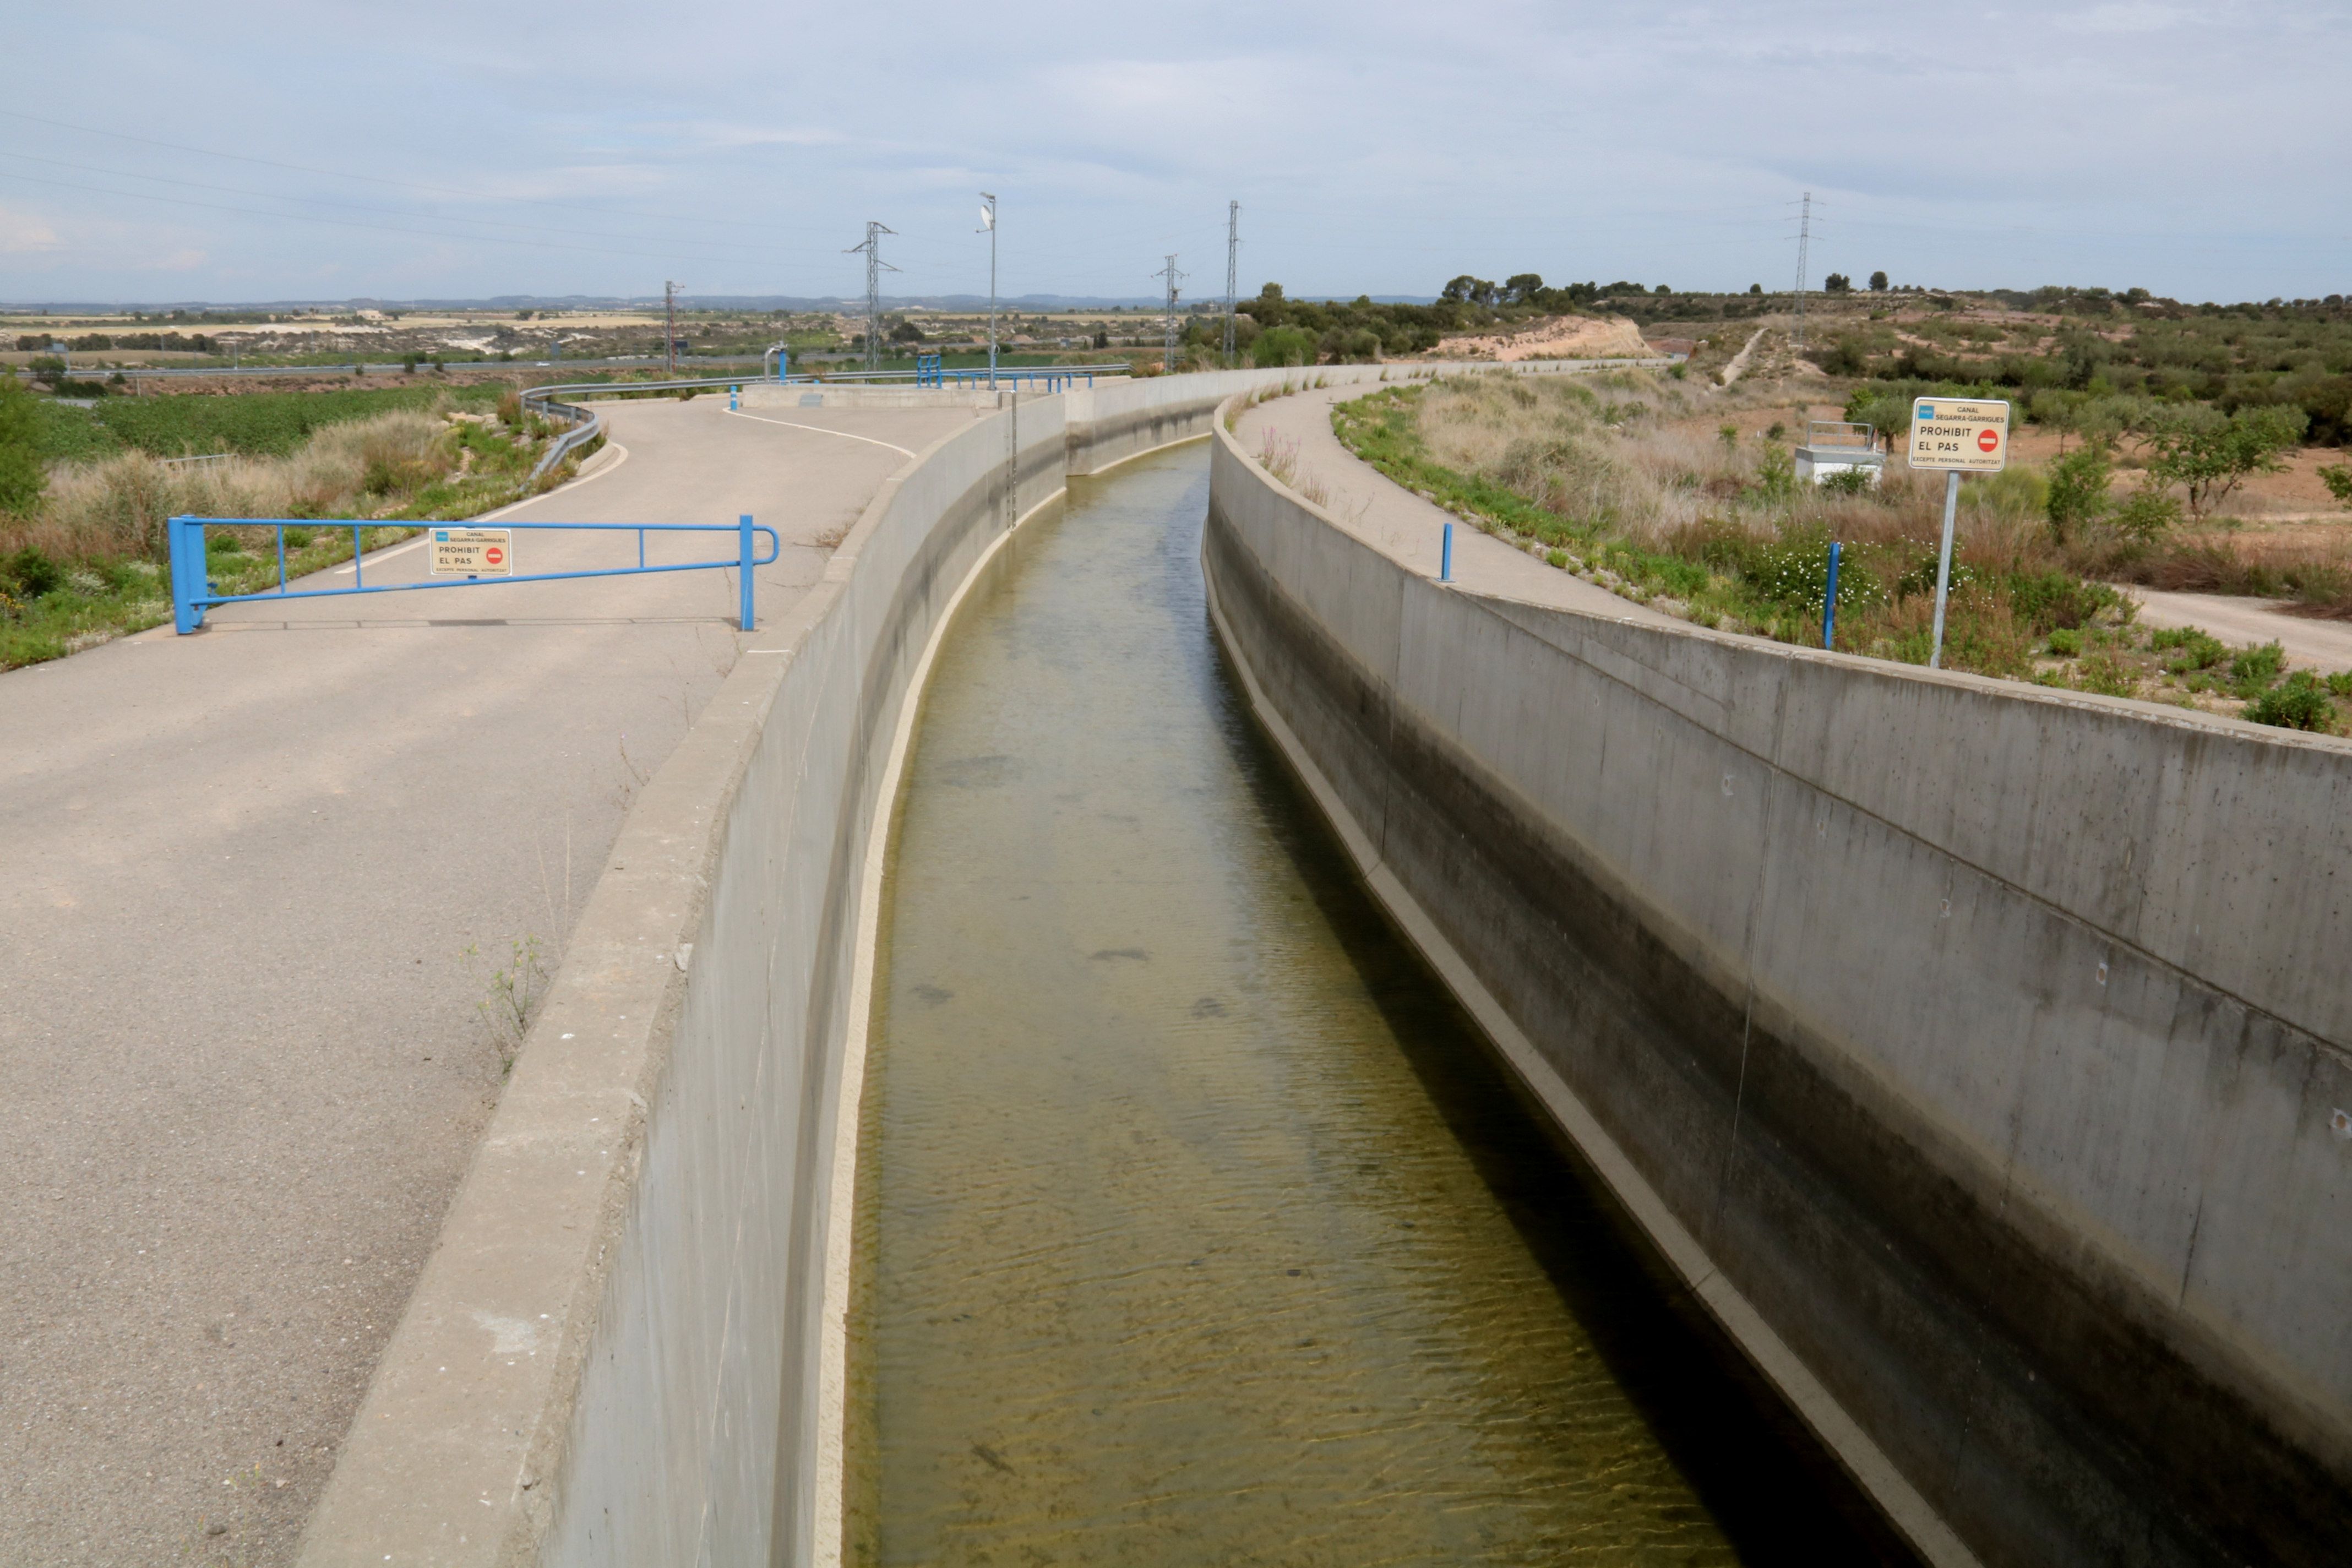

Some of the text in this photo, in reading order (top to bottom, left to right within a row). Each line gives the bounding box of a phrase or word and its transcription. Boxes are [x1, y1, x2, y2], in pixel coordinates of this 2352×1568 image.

[1935, 414, 2005, 423] SEGARRA-GARRIGUES
[1920, 426, 1972, 437] PROHIBIT
[1919, 442, 1959, 451] EL PAS
